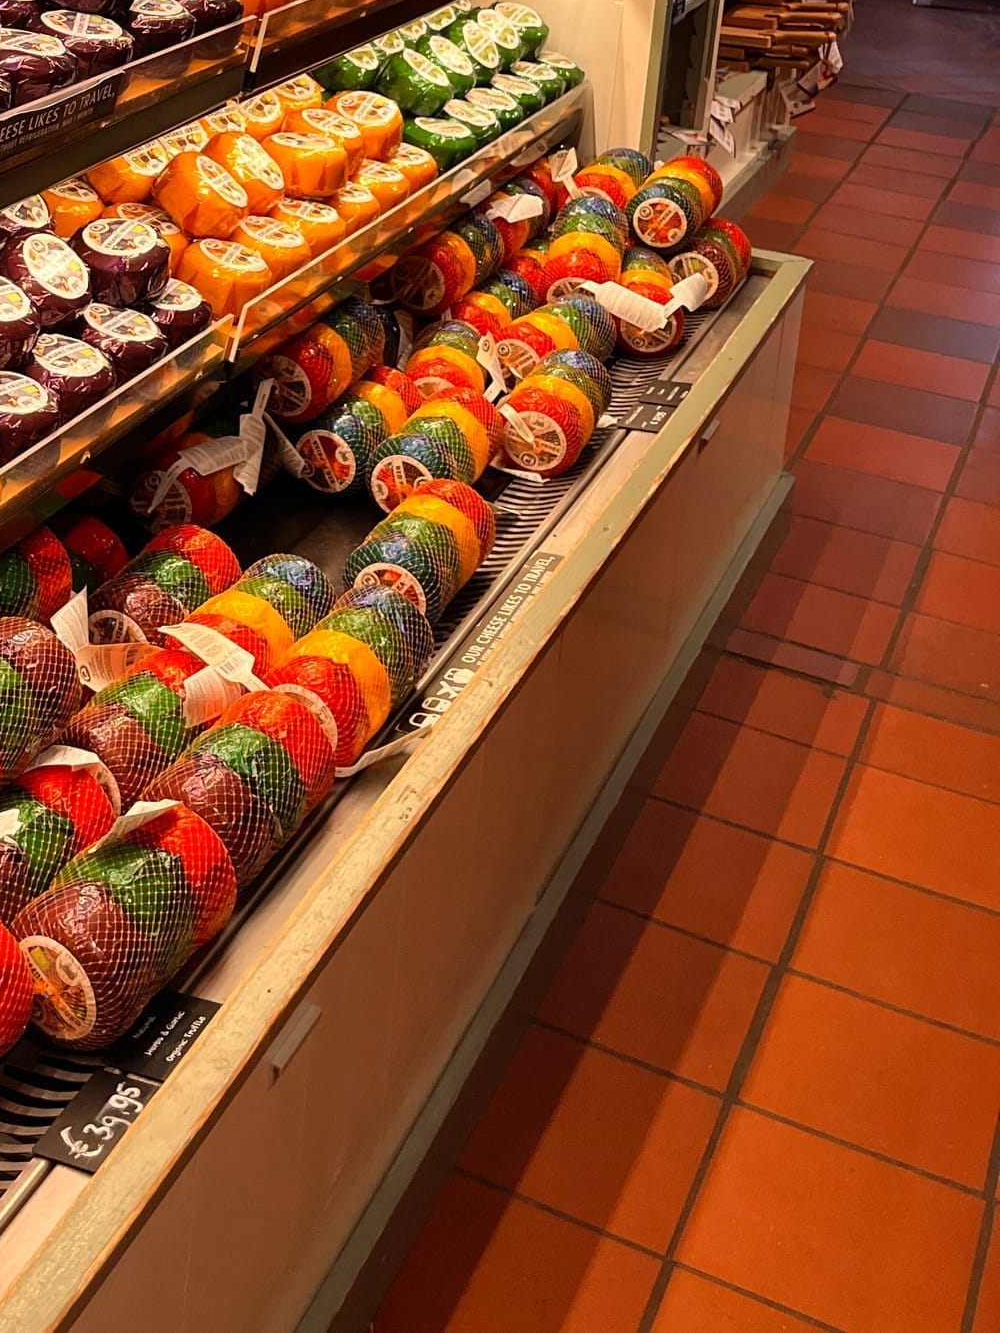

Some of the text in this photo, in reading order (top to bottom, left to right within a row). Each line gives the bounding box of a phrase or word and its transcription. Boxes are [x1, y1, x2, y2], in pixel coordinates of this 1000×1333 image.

[28, 106, 61, 132] LIKES
[63, 99, 78, 116] TO
[79, 82, 117, 111] TRAVEL,
[461, 643, 483, 664] OUR
[476, 615, 504, 648] CHEESE
[499, 590, 523, 621] LIKES
[514, 580, 532, 596] TO
[165, 1009, 187, 1034] Garlic
[165, 1015, 208, 1063] Organic Truffle
